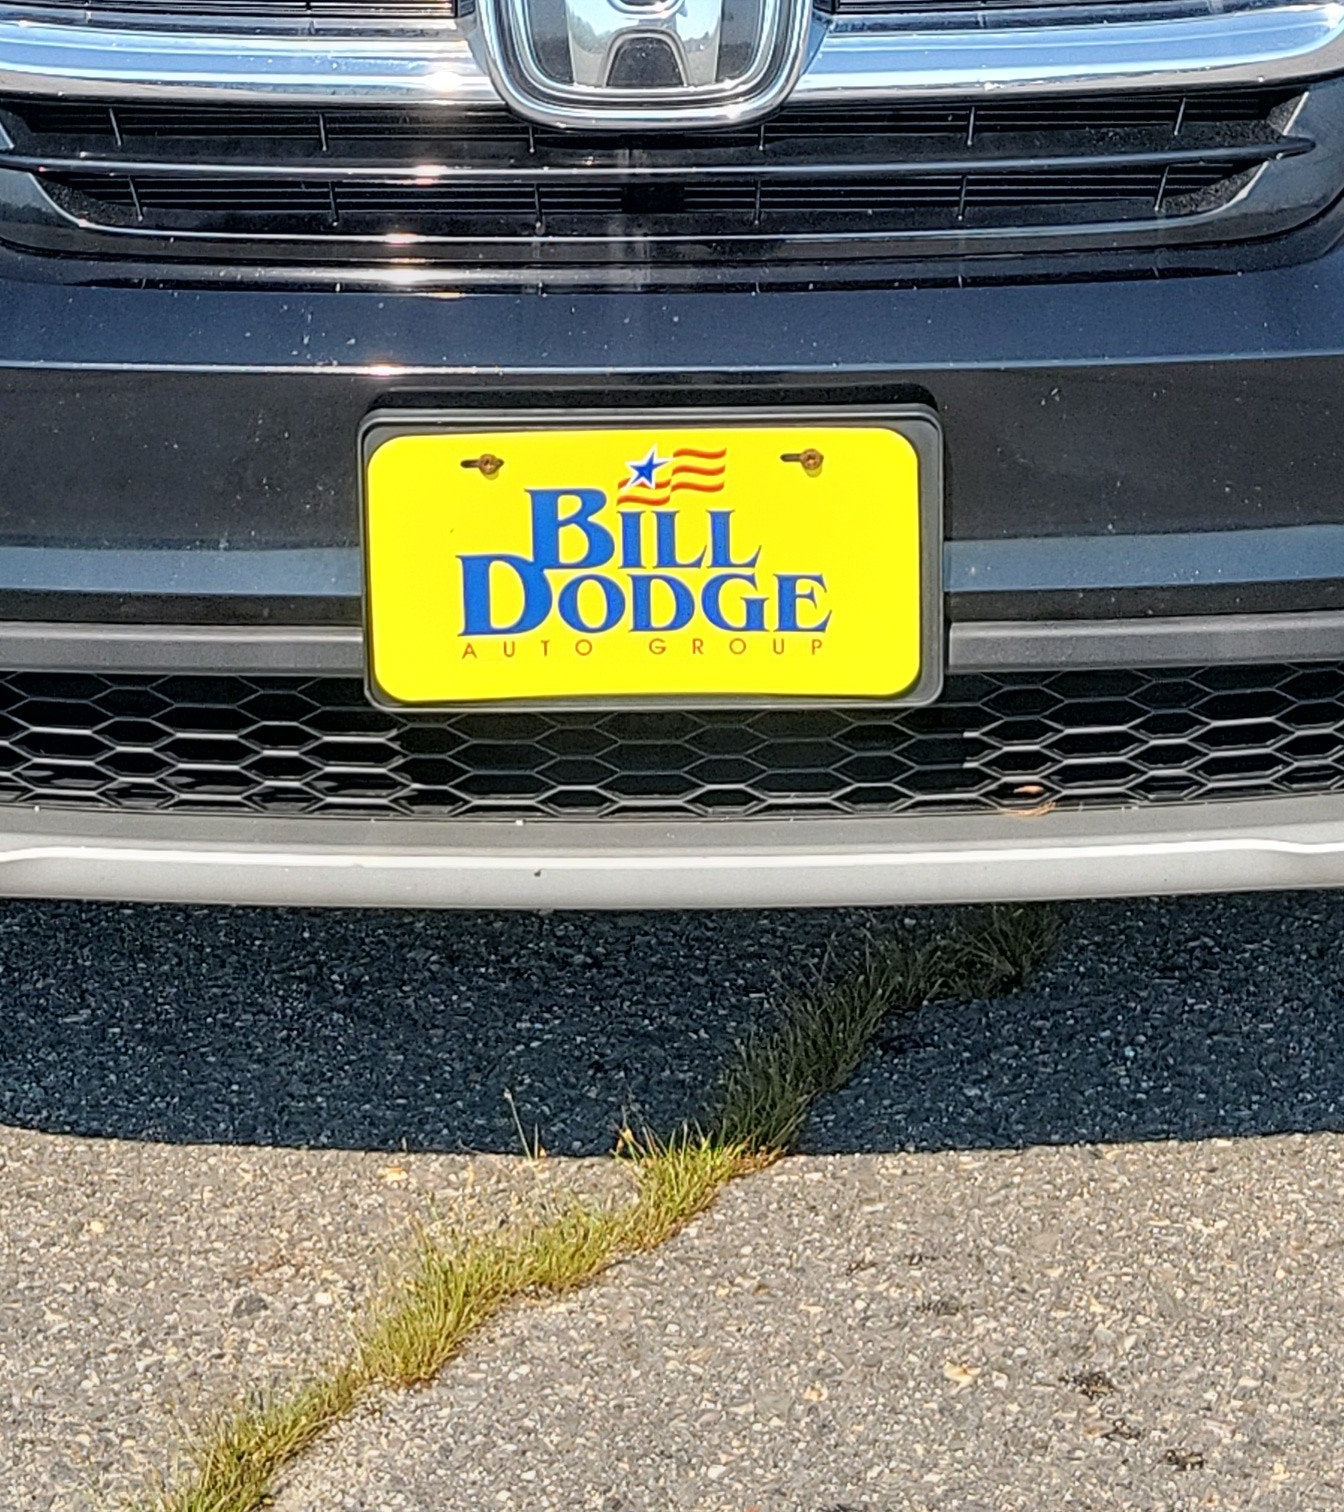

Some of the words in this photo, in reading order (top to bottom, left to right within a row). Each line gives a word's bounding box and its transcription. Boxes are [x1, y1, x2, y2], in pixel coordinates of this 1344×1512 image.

[523, 488, 762, 570] BILL
[456, 552, 833, 637] DODGE
[461, 638, 594, 660] AUTO
[648, 635, 824, 657] GROUP
